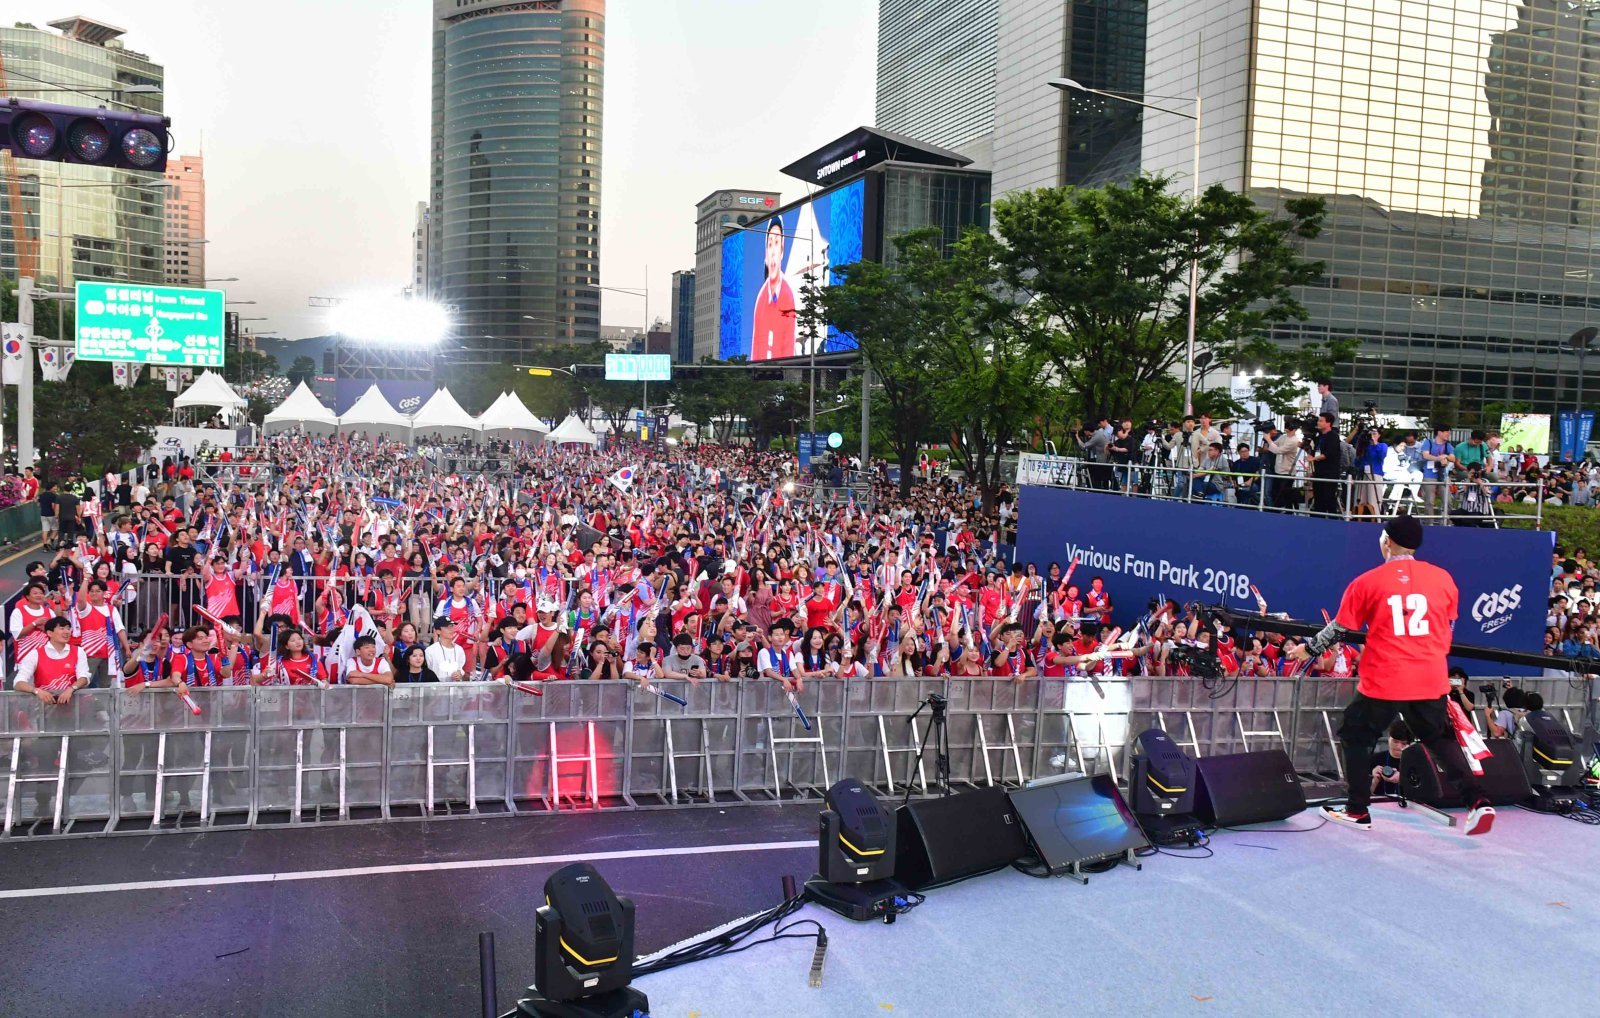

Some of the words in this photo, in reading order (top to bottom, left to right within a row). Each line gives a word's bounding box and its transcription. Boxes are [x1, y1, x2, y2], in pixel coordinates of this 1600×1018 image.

[739, 196, 763, 205] SGF
[1066, 542, 1121, 572] Various
[1124, 553, 1155, 580] Fan
[1159, 560, 1199, 589] Park
[1202, 568, 1250, 599] 2018
[1387, 593, 1430, 637] 12
[1481, 613, 1513, 633] FRESH
